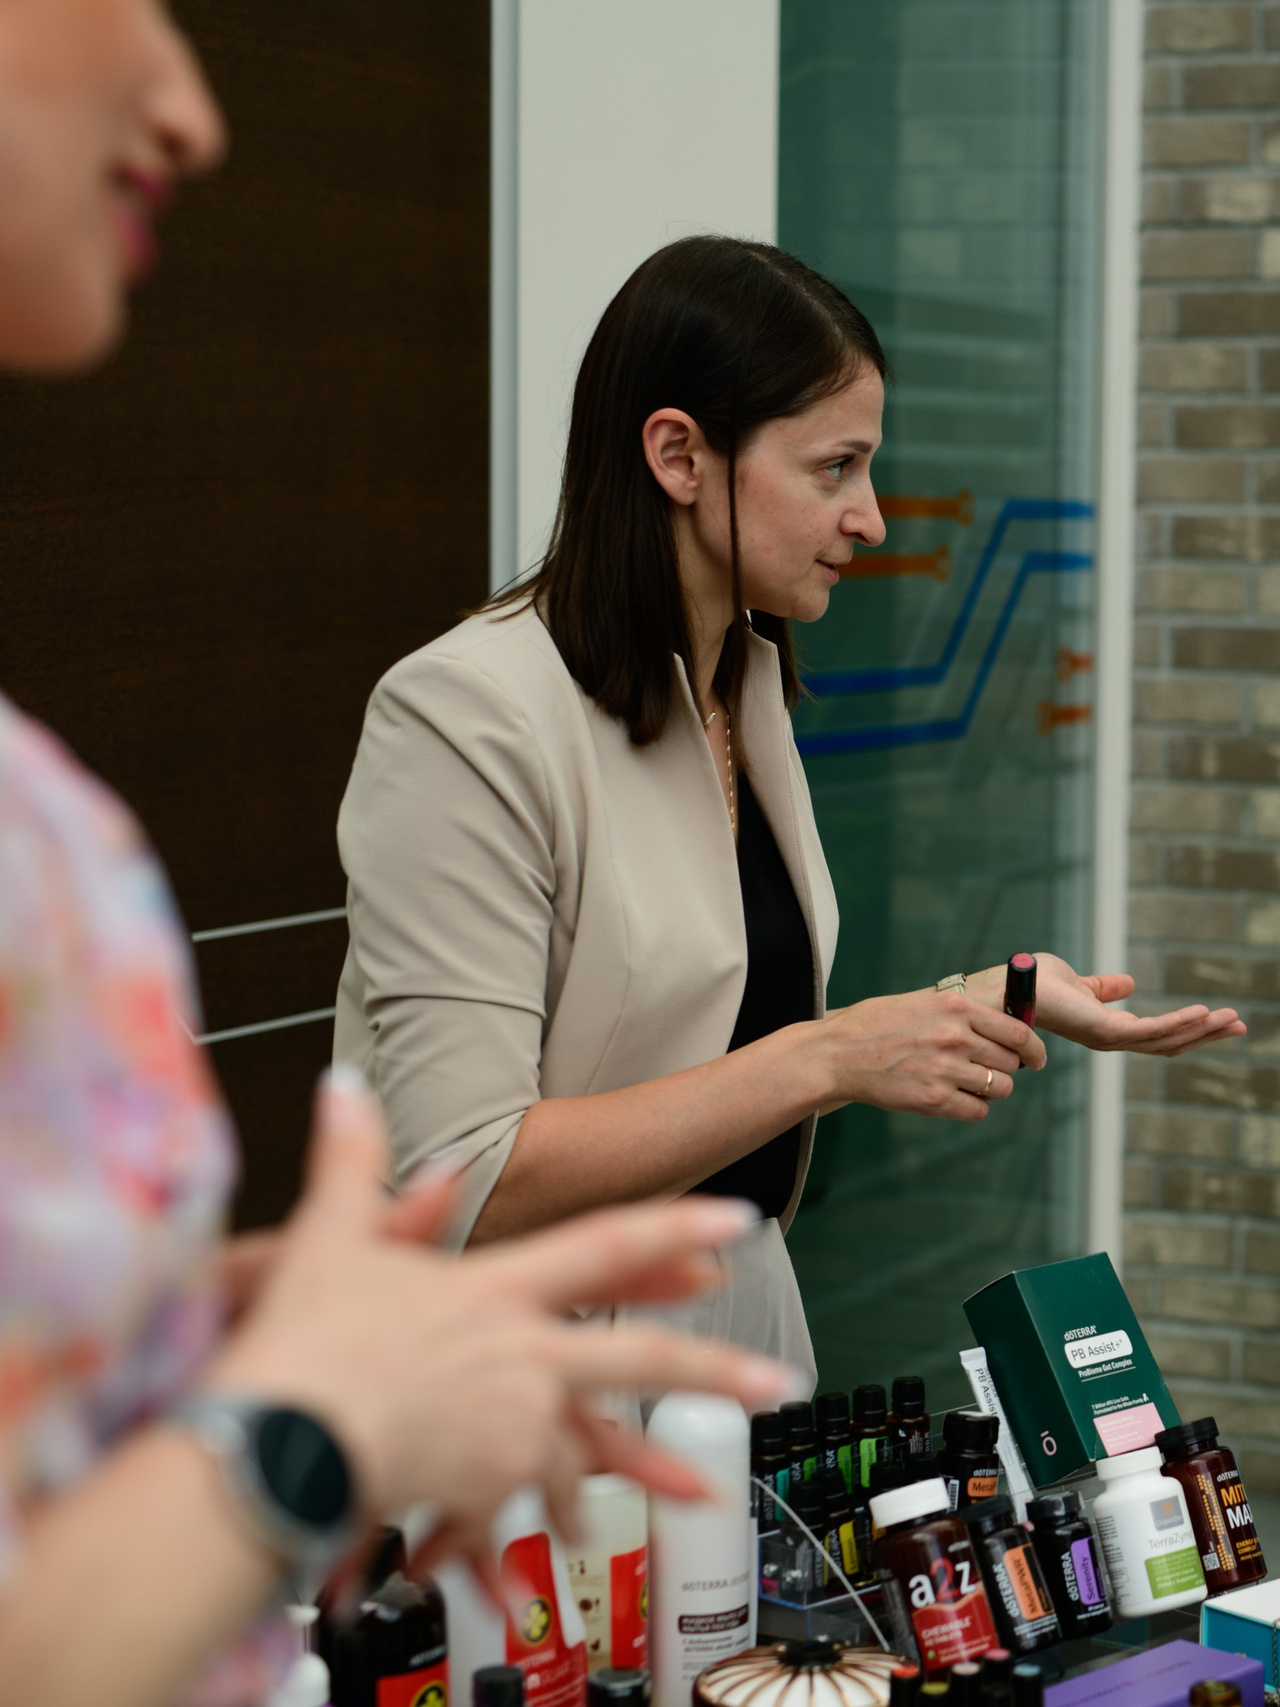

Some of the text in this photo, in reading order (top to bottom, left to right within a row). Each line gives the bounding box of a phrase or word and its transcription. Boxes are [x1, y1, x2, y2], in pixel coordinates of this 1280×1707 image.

[1071, 1348, 1086, 1361] PB
[1078, 1358, 1133, 1378] ProBiome Gut Complex
[975, 1368, 998, 1416] PB Assist
[1220, 1483, 1248, 1508] MIT
[908, 1557, 977, 1608] a2z
[1081, 1556, 1097, 1601] Serenity
[921, 1616, 972, 1641] CHEWABLE
